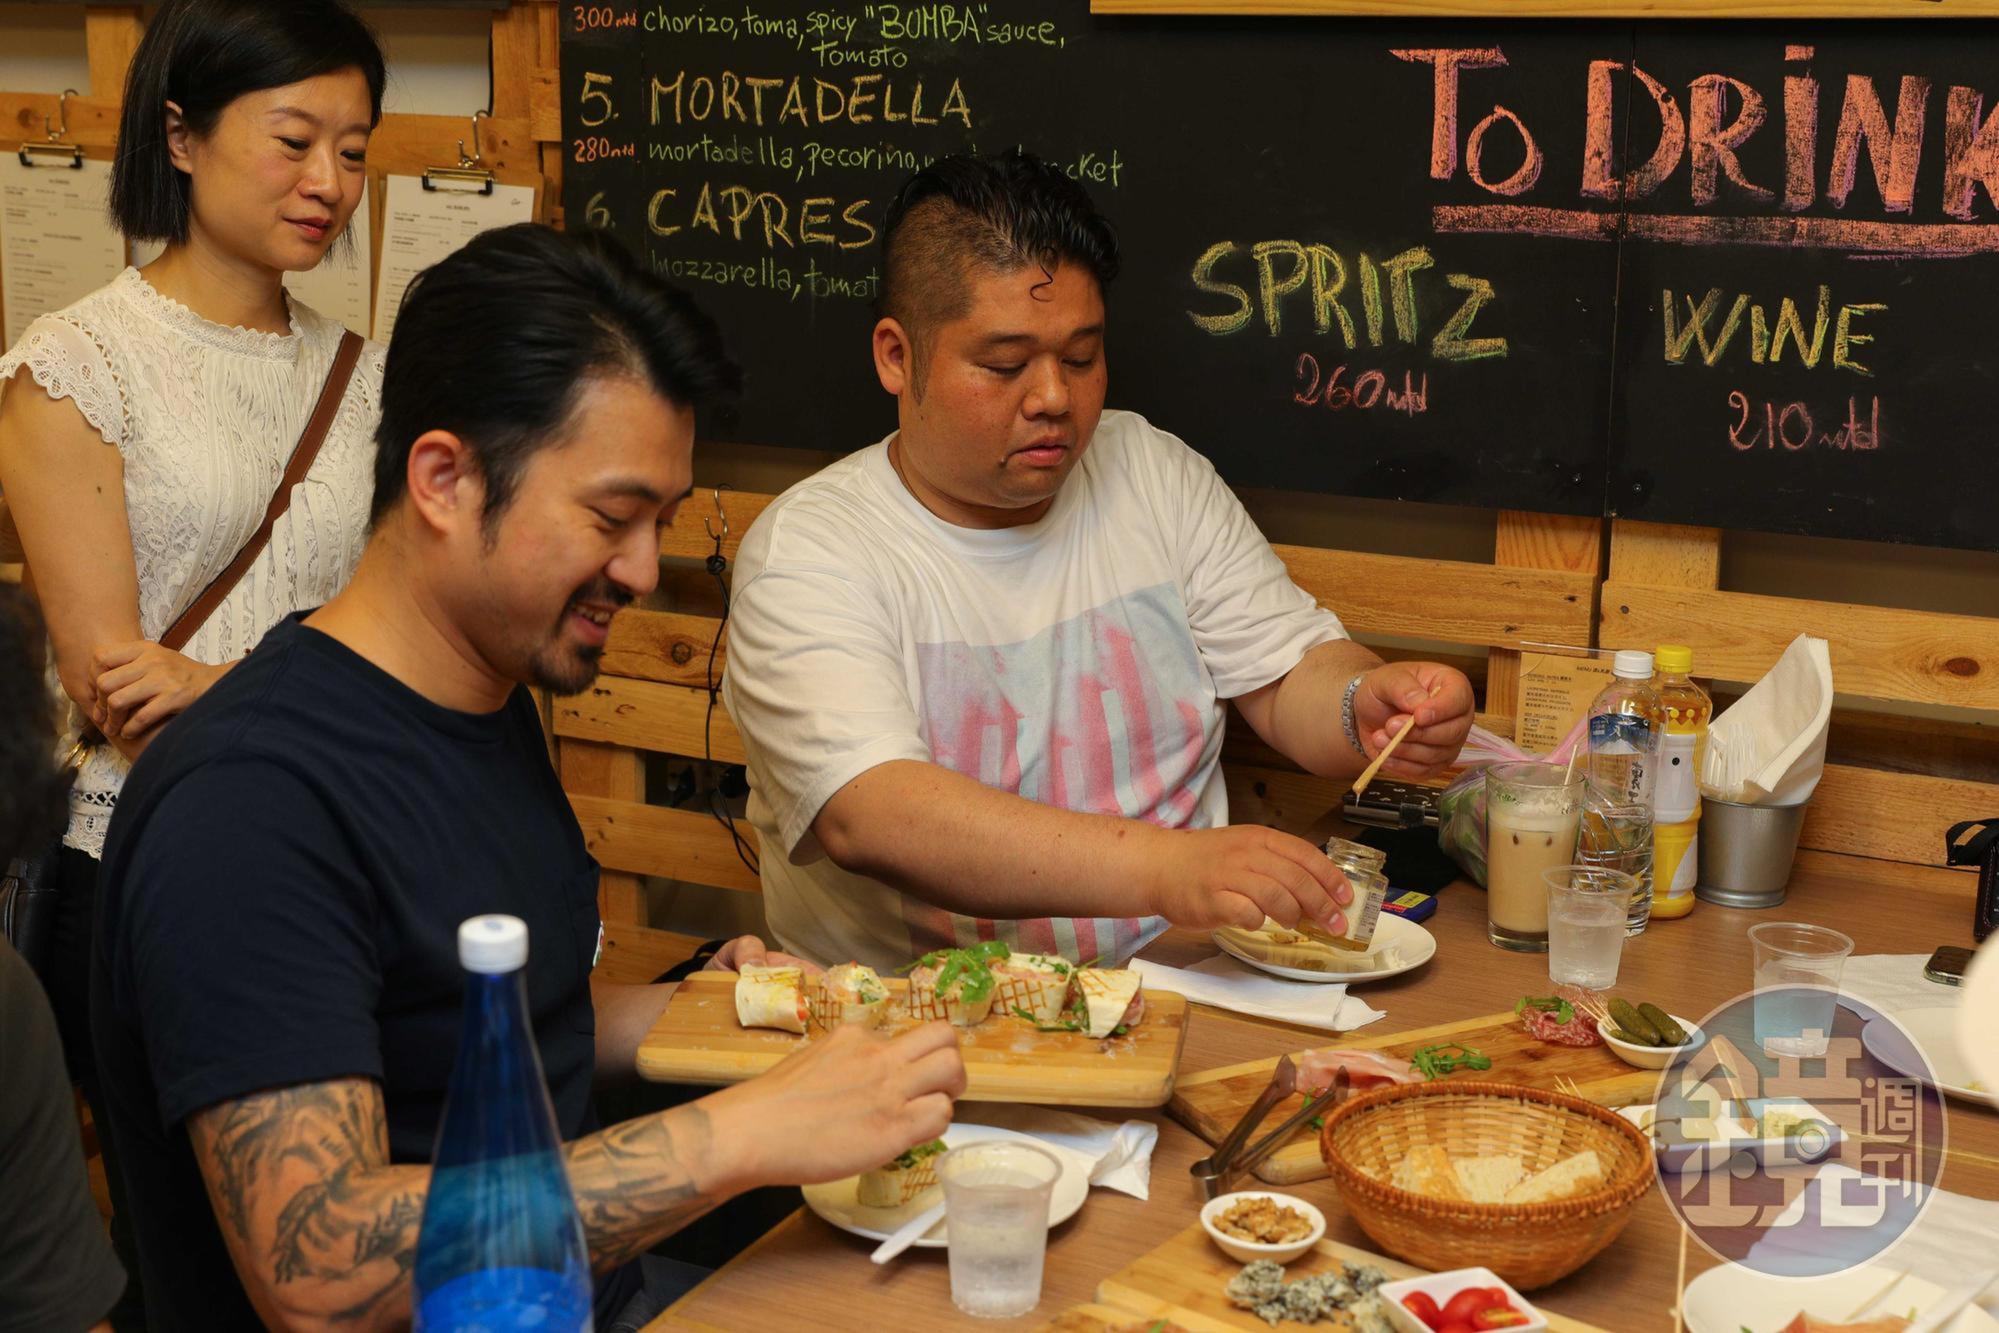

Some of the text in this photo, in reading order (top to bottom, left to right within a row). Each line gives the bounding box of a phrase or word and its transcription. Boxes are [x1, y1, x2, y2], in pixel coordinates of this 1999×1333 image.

[581, 71, 972, 128] 5. MORTADELLA
[648, 182, 877, 249] CAPRES
[803, 257, 881, 298] tomat
[1187, 240, 1510, 361] SPRITZ
